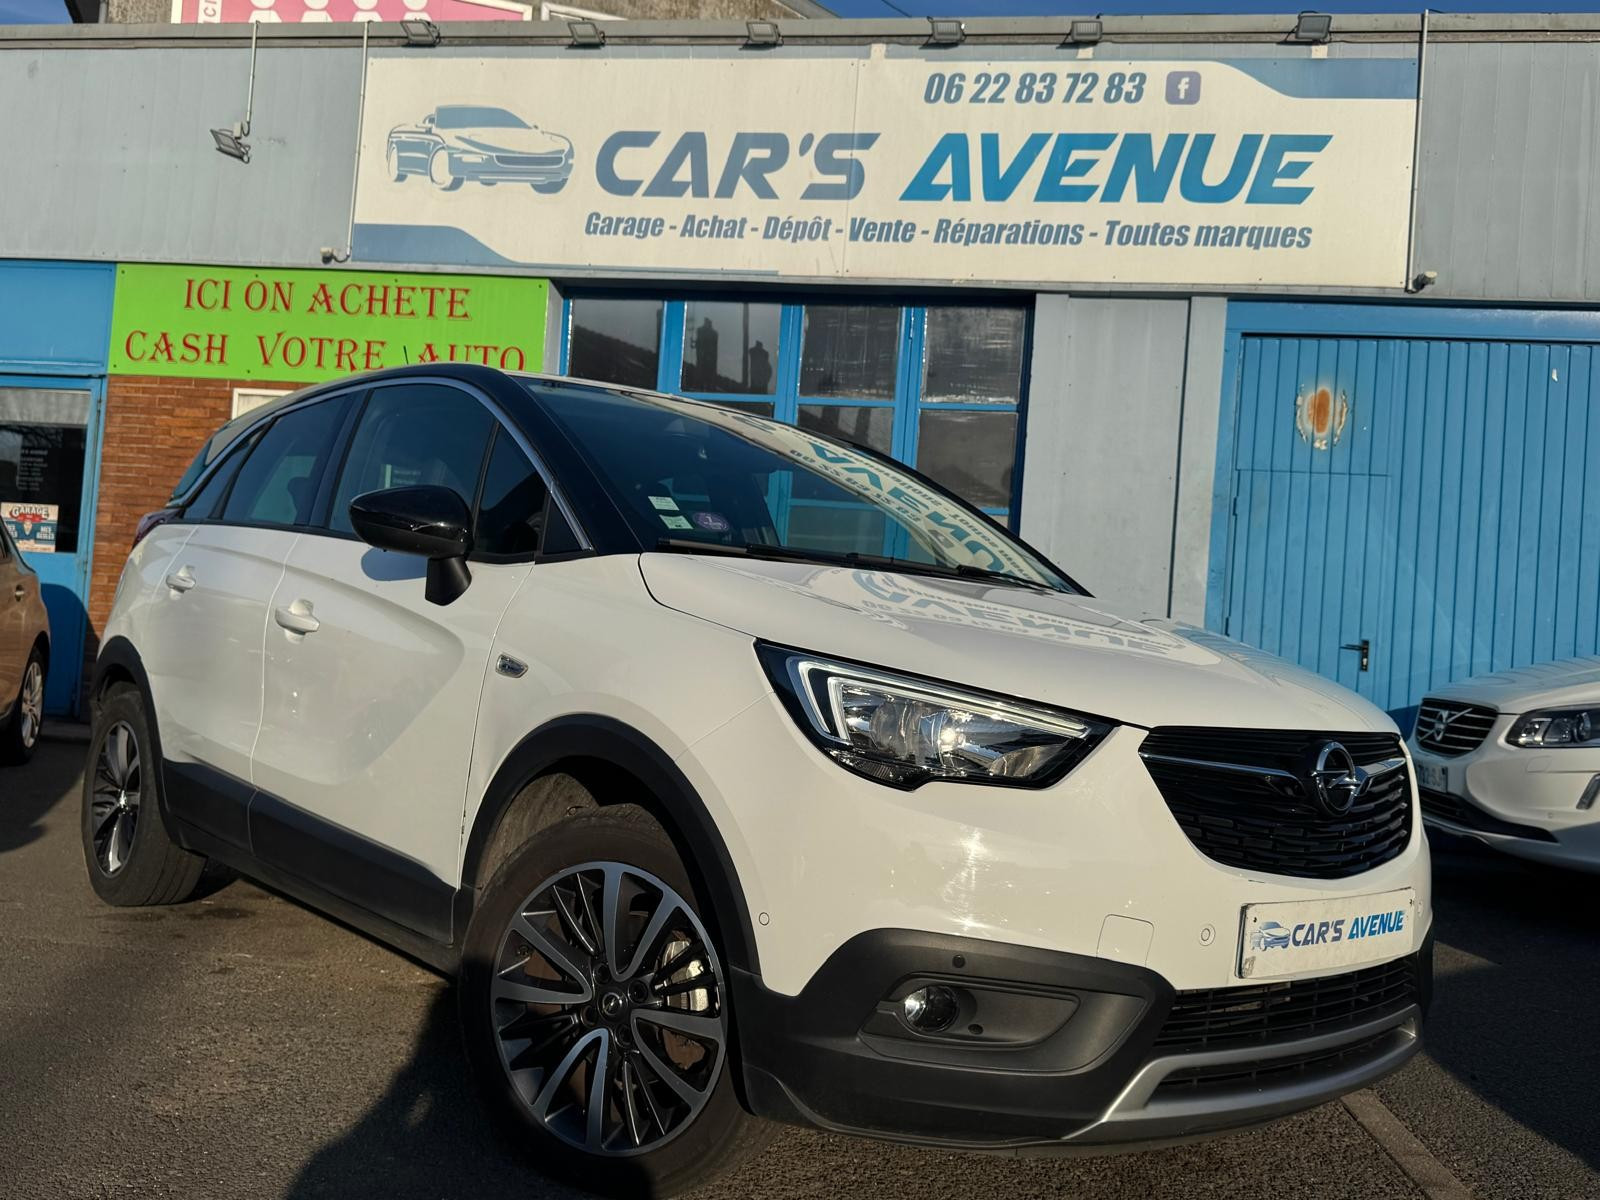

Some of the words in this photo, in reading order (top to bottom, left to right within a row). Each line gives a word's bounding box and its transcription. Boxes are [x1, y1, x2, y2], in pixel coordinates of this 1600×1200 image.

[924, 72, 965, 104] 06
[968, 72, 1012, 104] 22
[1015, 73, 1058, 104] 83
[1062, 73, 1099, 104] 72
[1103, 73, 1147, 104] 83
[595, 130, 881, 201] CAR'S
[899, 132, 1334, 205] AVENUE
[584, 212, 665, 240] Garage
[680, 214, 748, 240] Achat
[762, 215, 833, 244] Dépôt
[849, 217, 916, 244] Vente
[933, 217, 1085, 247] Réparations
[1105, 220, 1191, 248] Toutes
[1194, 223, 1312, 250] marques
[184, 278, 232, 312] ICI
[244, 280, 294, 313] ON
[306, 283, 472, 320] ACHETE
[125, 329, 229, 365] CASH
[257, 331, 387, 372] VOTRE
[418, 342, 526, 371] AUTO
[1291, 919, 1346, 947] CAR'S
[1348, 910, 1407, 940] AVENUE
